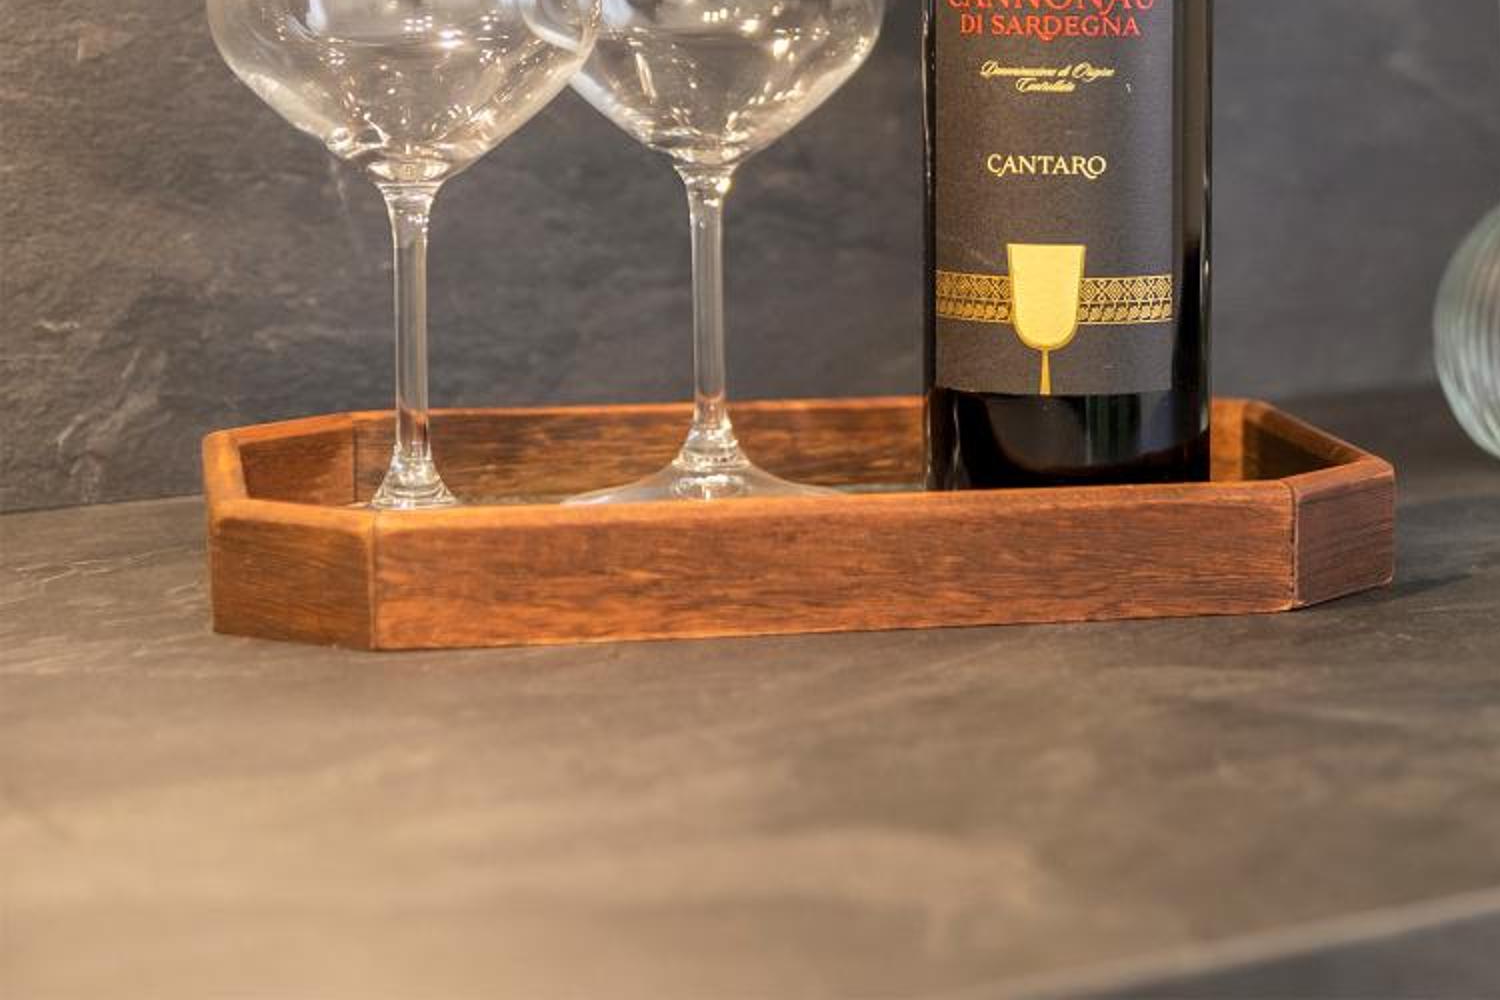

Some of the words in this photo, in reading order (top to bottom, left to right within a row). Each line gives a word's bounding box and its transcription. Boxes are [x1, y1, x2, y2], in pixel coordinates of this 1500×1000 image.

[960, 14, 983, 34] DI
[991, 14, 1141, 41] SARDEGNA
[987, 153, 1107, 179] CANTARO
